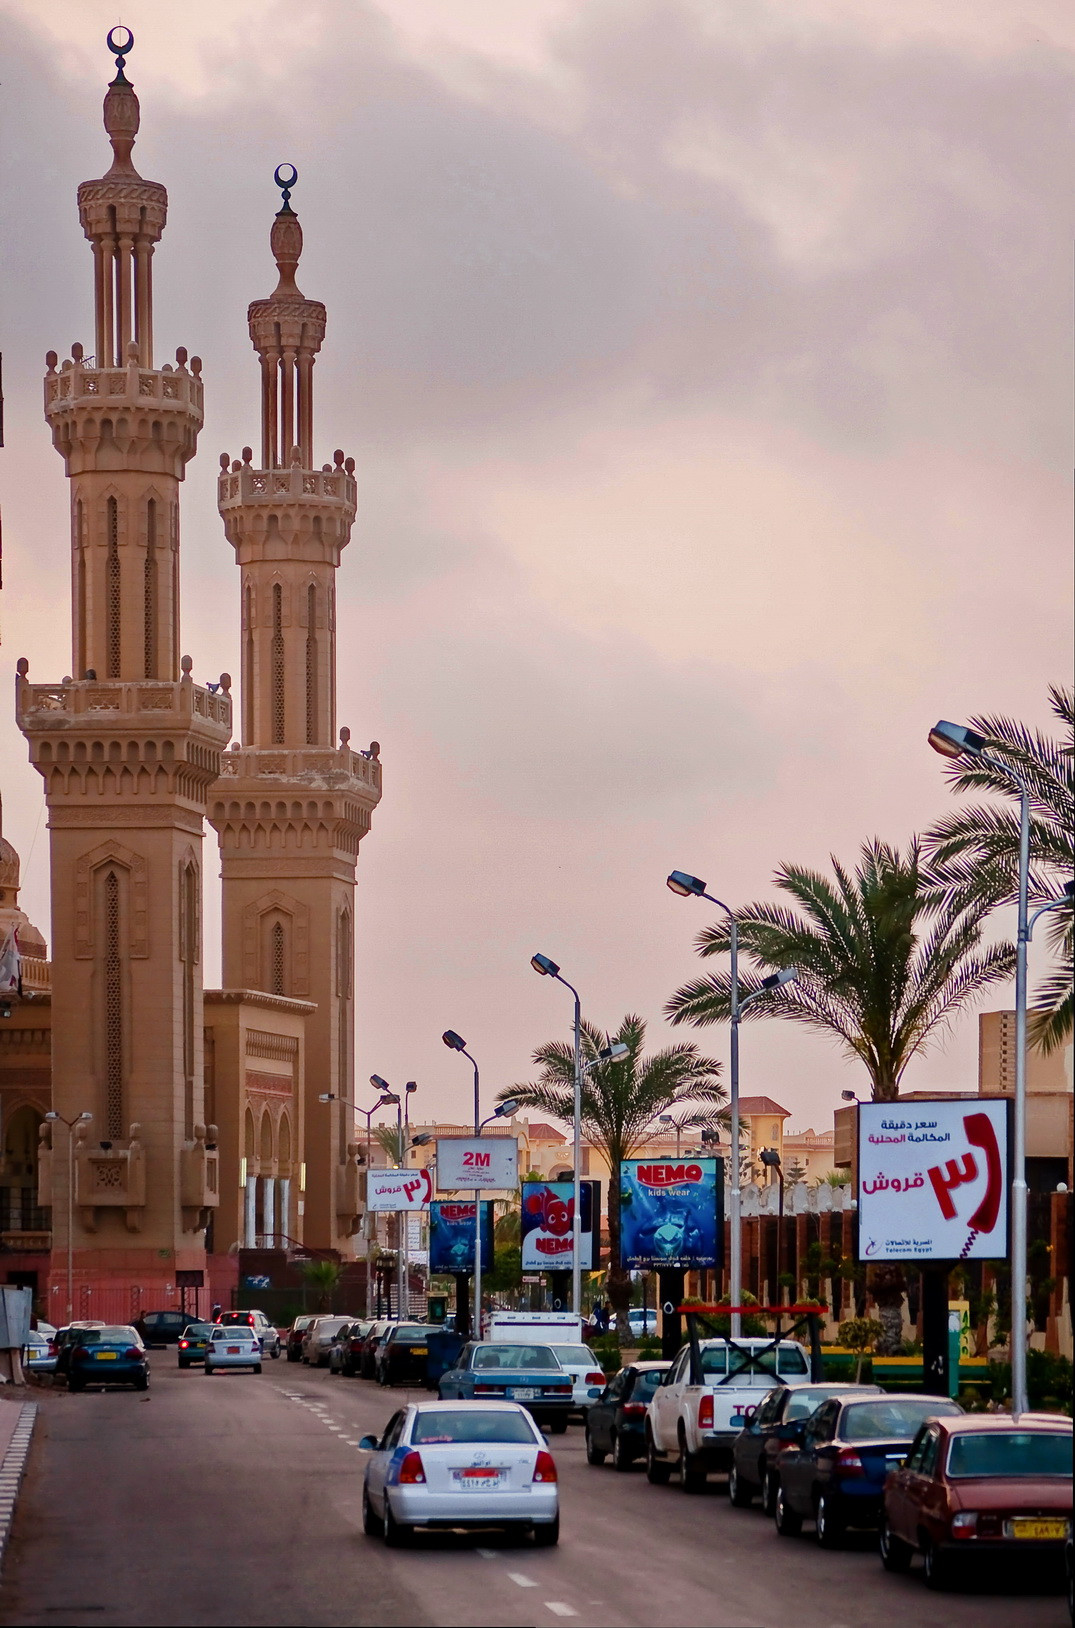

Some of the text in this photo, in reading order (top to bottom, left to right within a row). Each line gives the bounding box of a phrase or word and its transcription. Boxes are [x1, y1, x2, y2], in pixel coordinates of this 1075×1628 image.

[880, 1119, 938, 1131] سعر دقيقة
[868, 1132, 951, 1146] المكالمة المحلية
[462, 1151, 491, 1167] 2M
[636, 1163, 703, 1184] NEMO
[375, 1179, 421, 1202] ٣ قروش
[648, 1189, 691, 1197] kids wear
[862, 1152, 977, 1221] ٣ قروش
